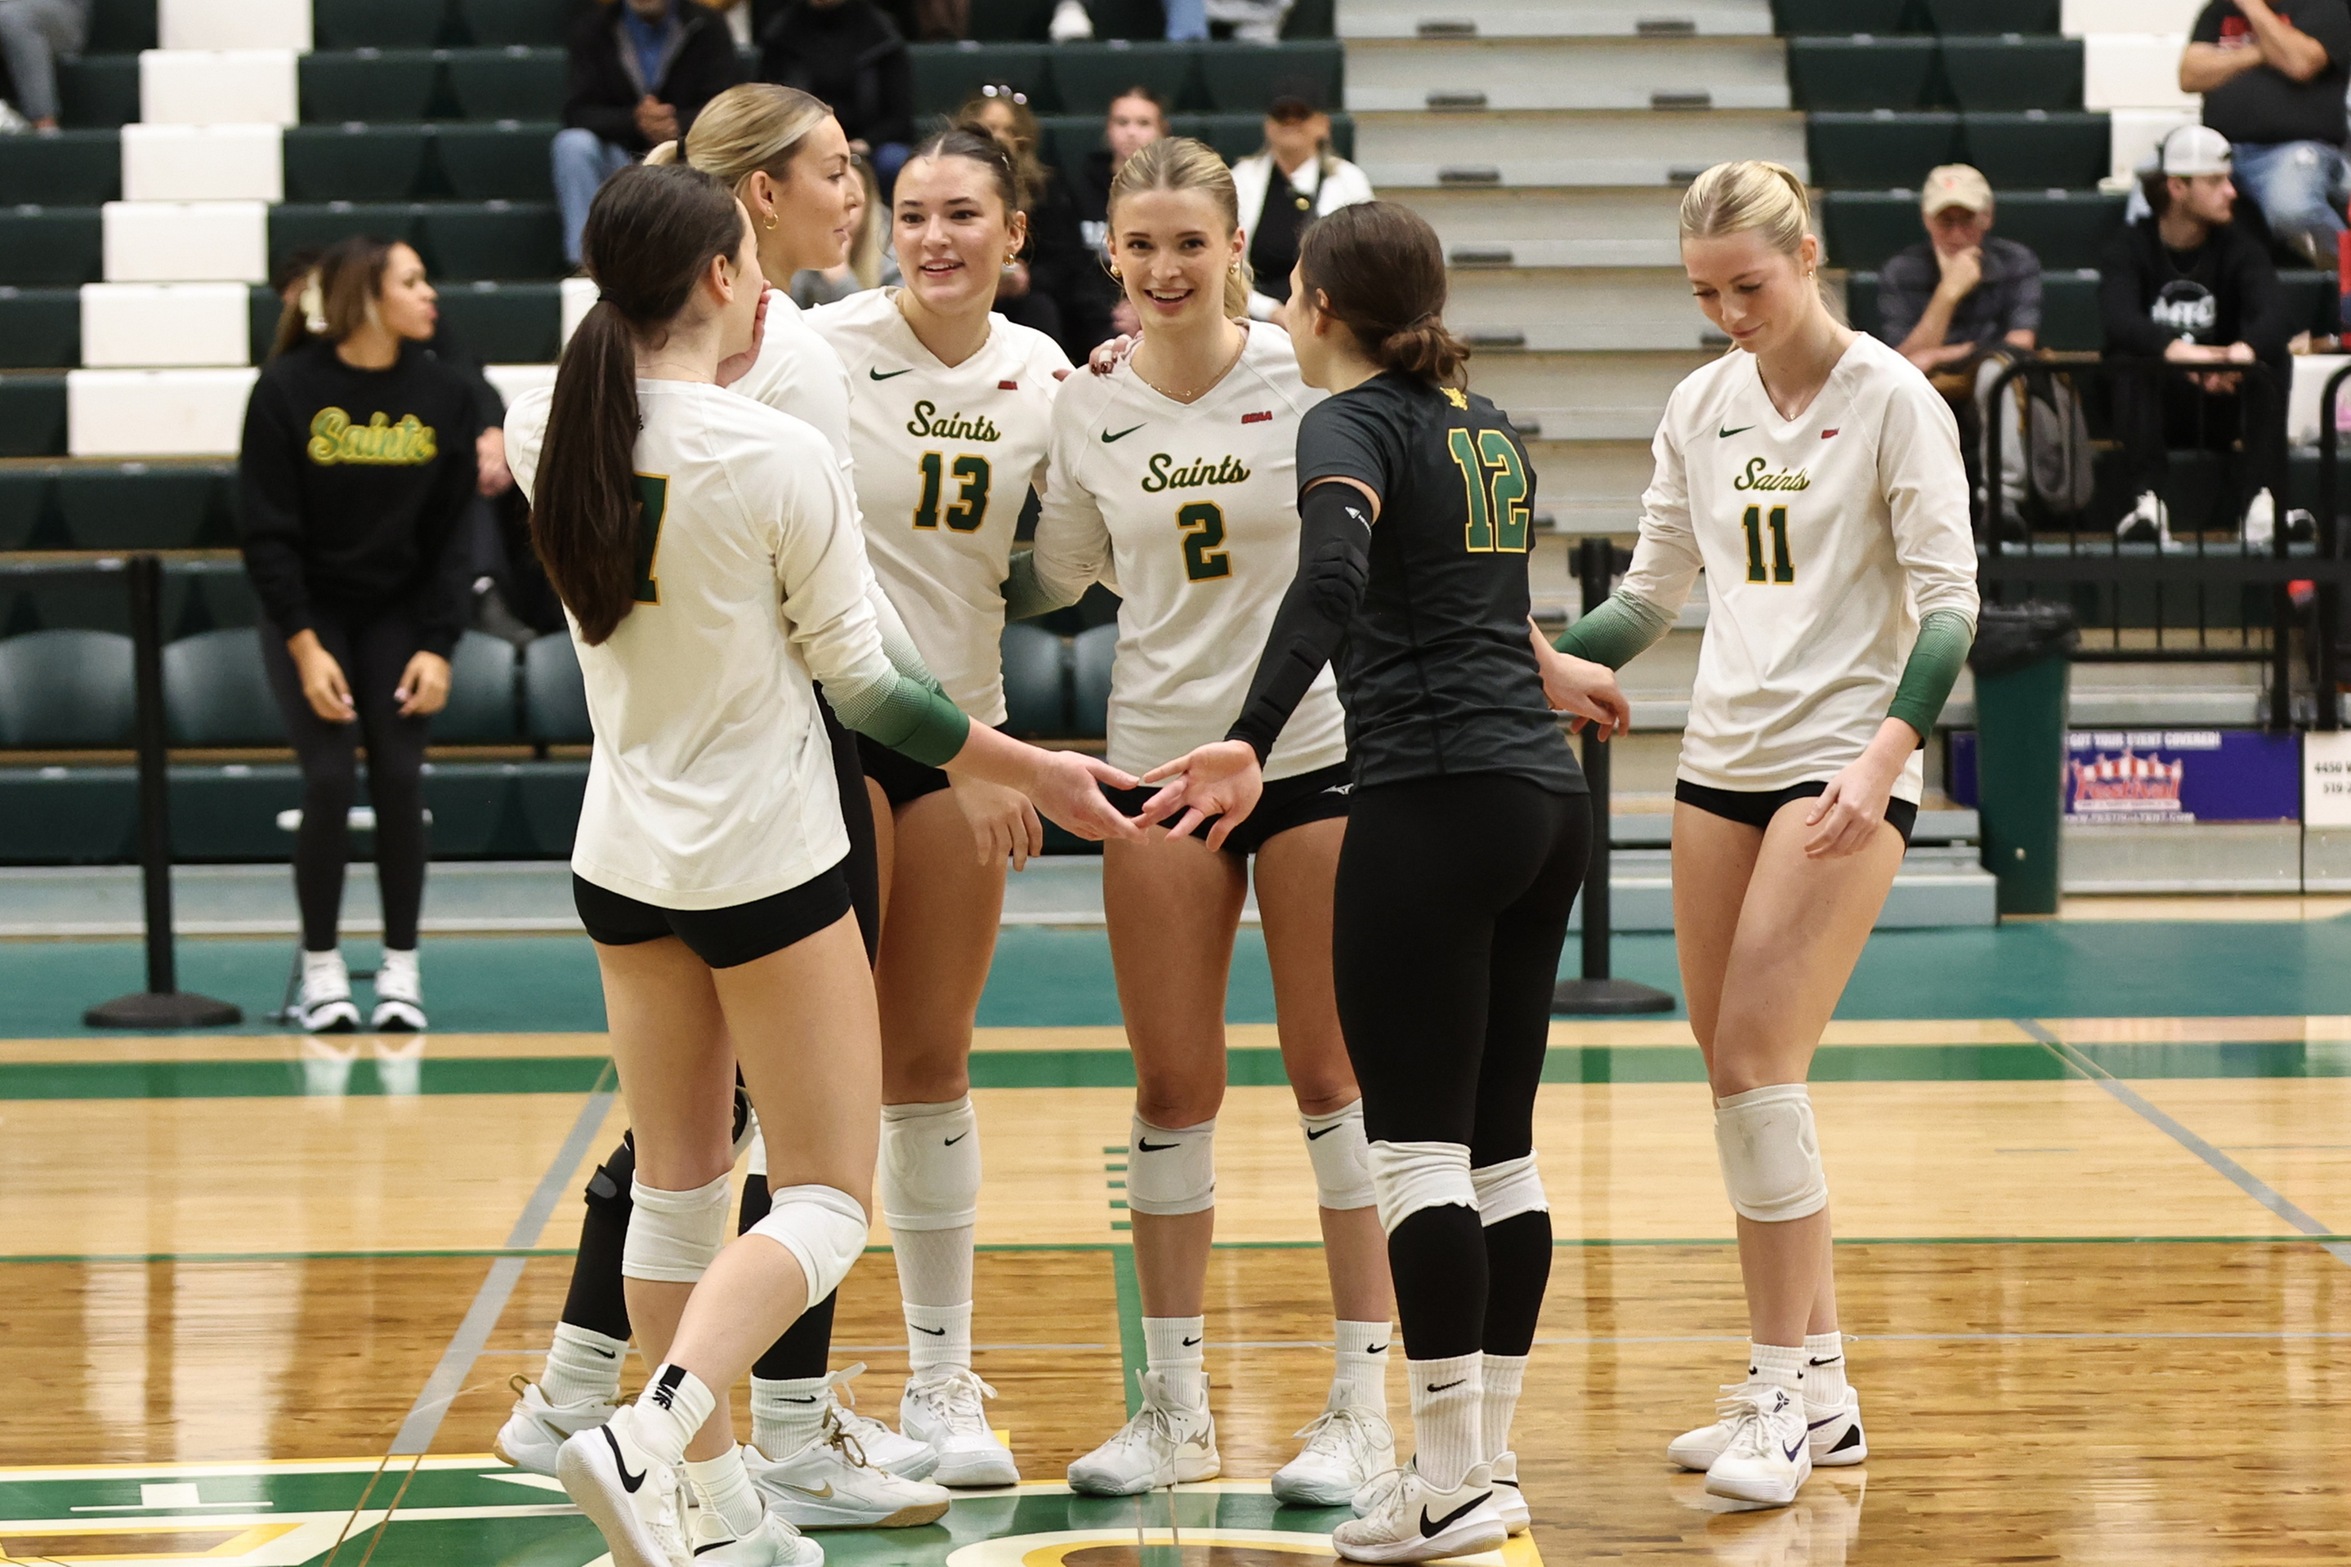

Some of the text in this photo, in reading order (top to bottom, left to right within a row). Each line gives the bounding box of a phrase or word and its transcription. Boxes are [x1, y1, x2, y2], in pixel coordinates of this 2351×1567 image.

[307, 406, 438, 466] Saints
[907, 400, 1001, 442] Saints
[912, 450, 992, 534] 13
[1141, 453, 1251, 493] Saints
[1448, 428, 1529, 553] 12
[1734, 457, 1810, 491] Saints
[1174, 500, 1233, 583] 2
[1741, 504, 1795, 586] 11
